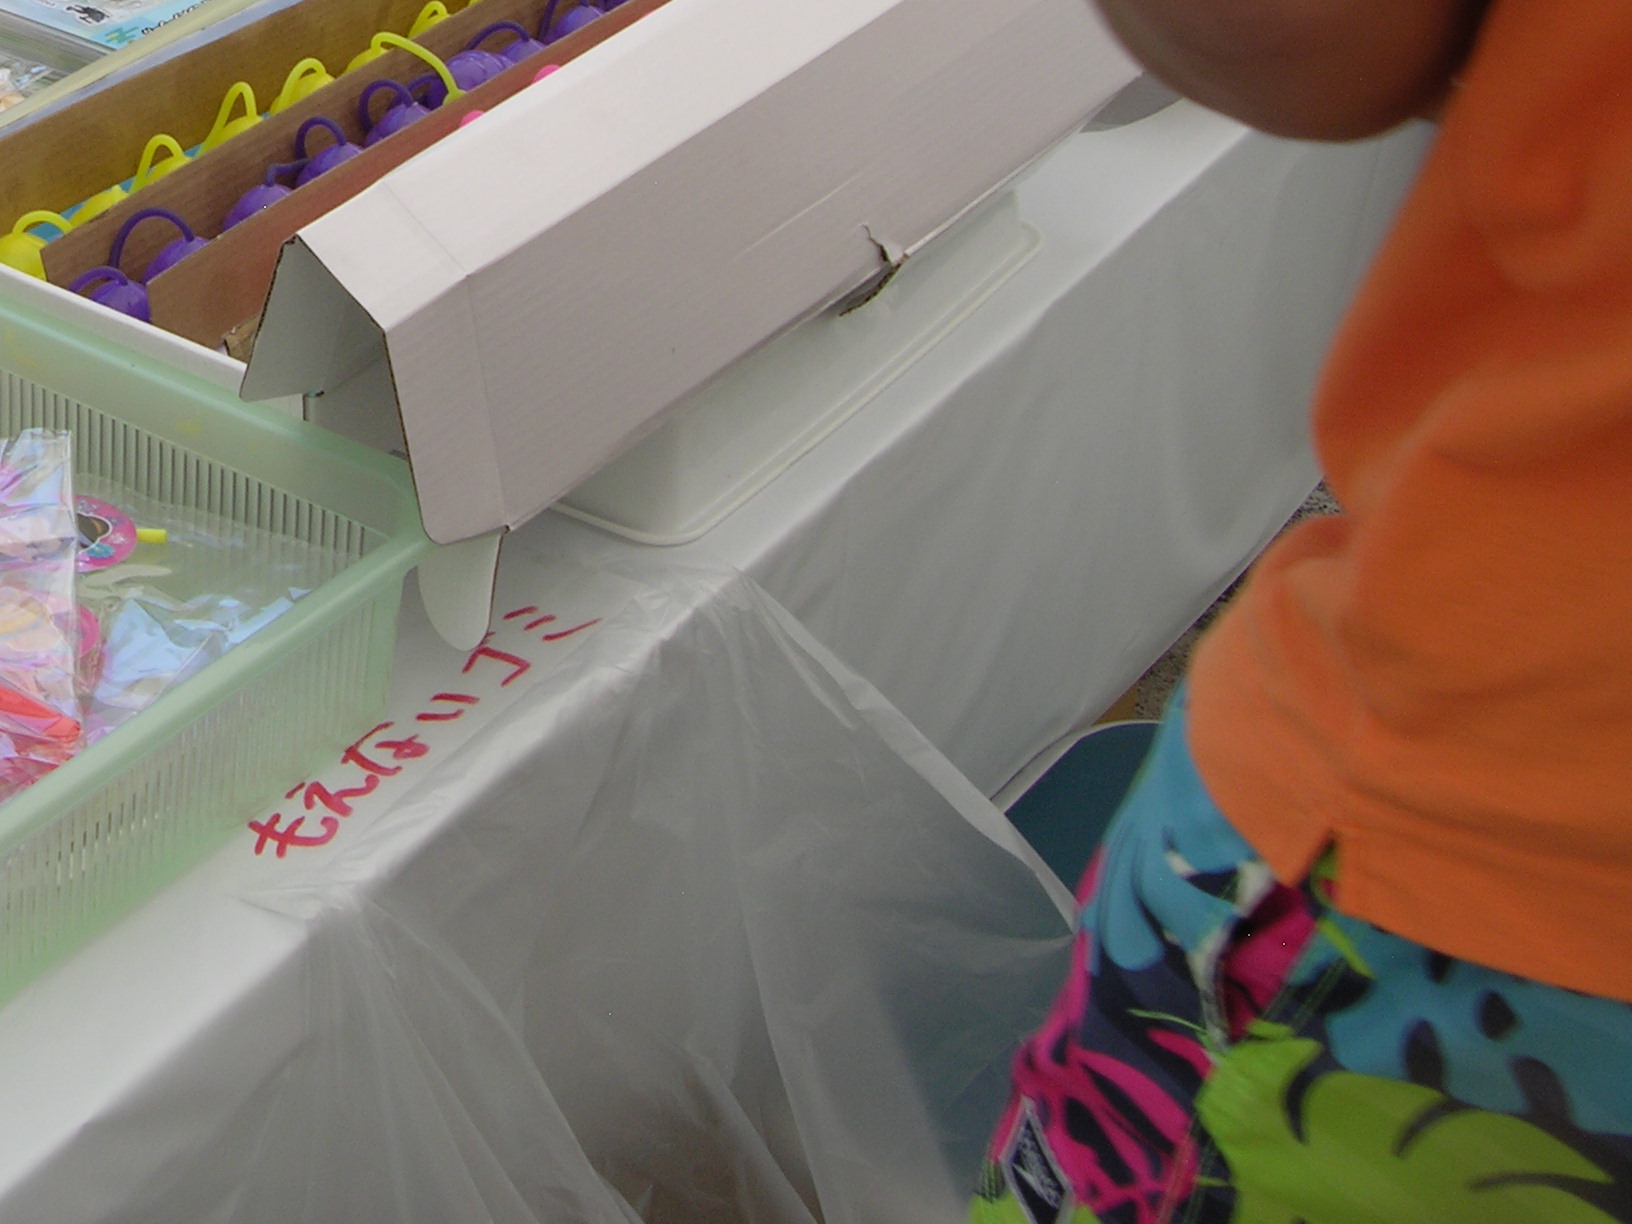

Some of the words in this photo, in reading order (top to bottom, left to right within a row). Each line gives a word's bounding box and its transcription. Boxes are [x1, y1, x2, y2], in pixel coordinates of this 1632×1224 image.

[248, 605, 603, 859] もえないゴミ
